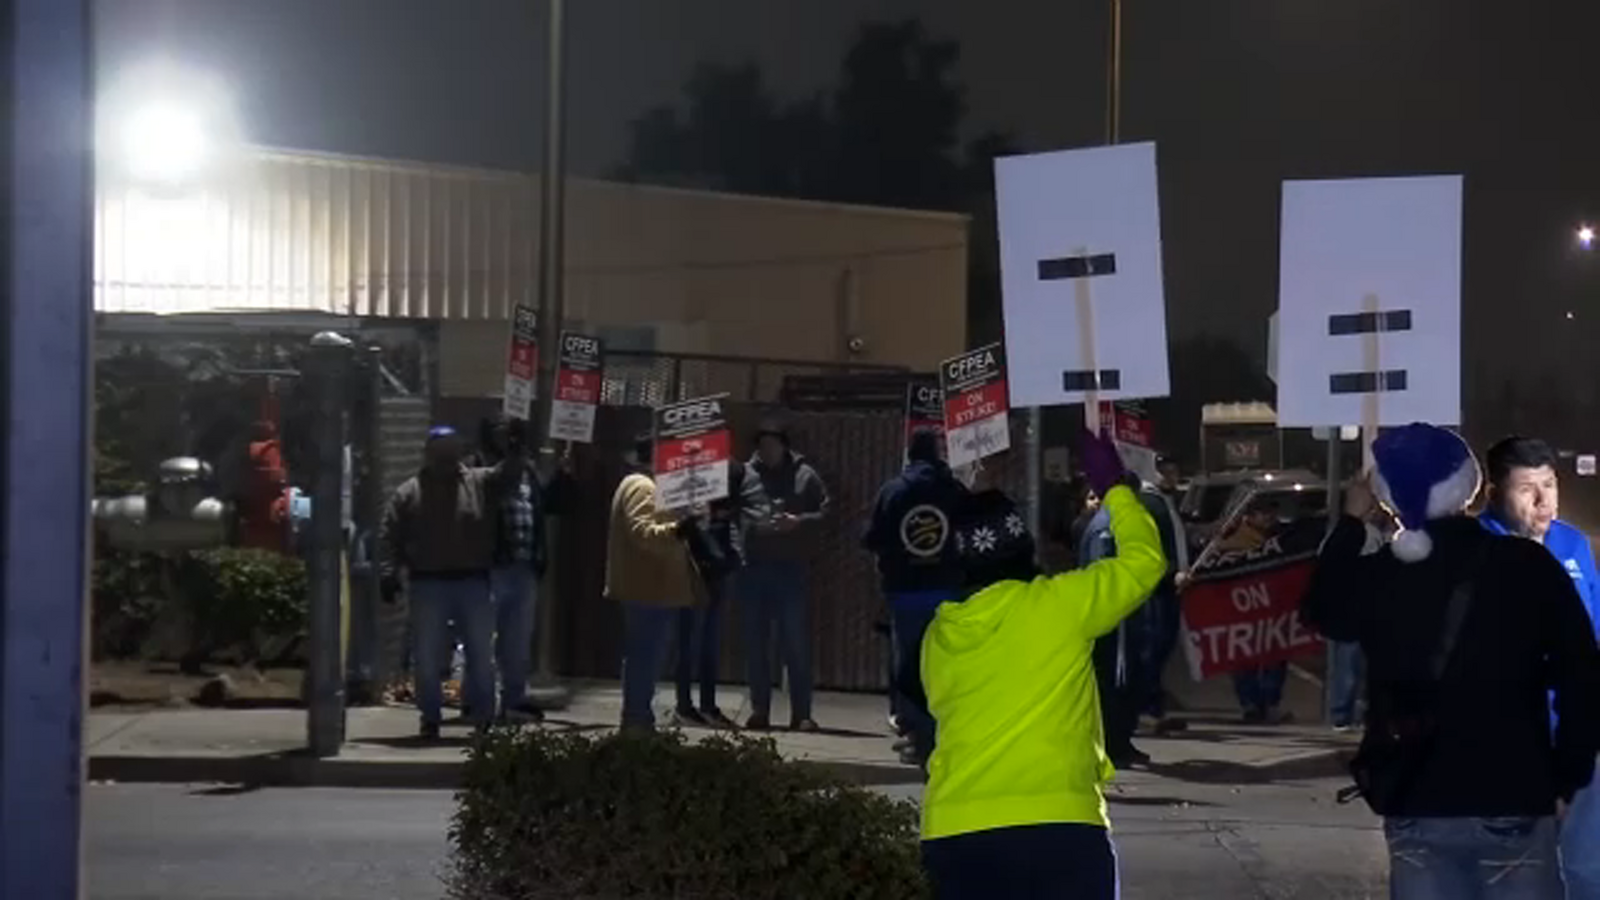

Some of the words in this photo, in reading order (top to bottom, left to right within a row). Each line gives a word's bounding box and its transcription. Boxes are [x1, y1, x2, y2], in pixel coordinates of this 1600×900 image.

[948, 350, 996, 379] CFPEA
[966, 391, 984, 406] ON
[664, 401, 721, 424] CFPEA
[1231, 582, 1271, 612] ON
